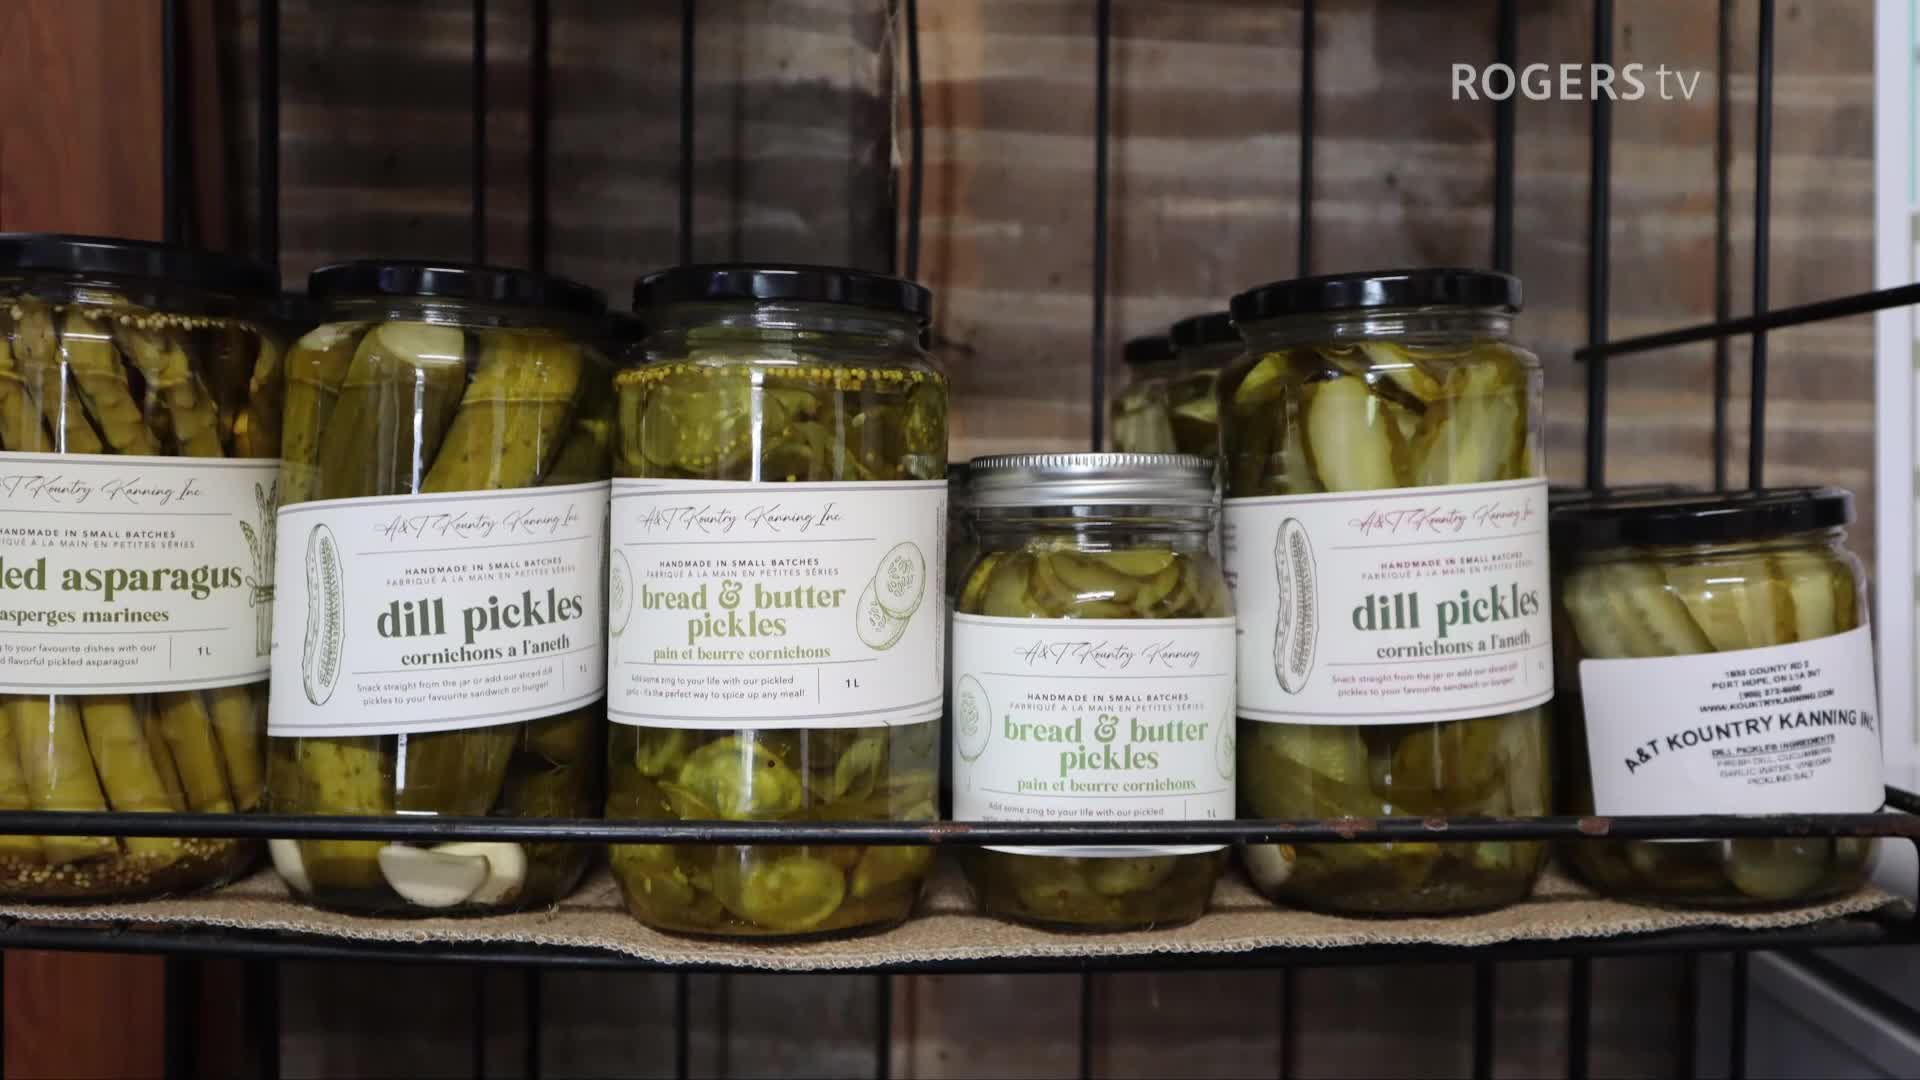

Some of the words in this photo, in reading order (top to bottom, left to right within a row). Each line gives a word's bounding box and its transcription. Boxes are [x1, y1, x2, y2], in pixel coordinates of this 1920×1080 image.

[25, 475, 92, 503] Kountry
[101, 477, 174, 505] Kanning
[432, 512, 497, 538] Kountry
[502, 507, 560, 534] Kanning
[679, 505, 737, 534] Kountry
[745, 504, 815, 532] Kanning
[61, 539, 88, 548] MAIN
[94, 540, 107, 548] EN
[83, 530, 120, 539] SMALL
[126, 531, 176, 539] BATCHES
[405, 564, 467, 575] HANDMADE
[472, 563, 484, 572] IN
[489, 561, 520, 571] SMALL
[524, 557, 562, 568] BATCHES
[659, 559, 712, 568] HANDMADE
[716, 559, 727, 568] IN
[732, 559, 766, 568] SMALL
[771, 558, 819, 567] BATCHES
[1381, 559, 1440, 570] HANDMADE
[1445, 558, 1456, 566] IN
[1460, 556, 1488, 564] SMALL
[469, 573, 494, 582] MAIN
[696, 569, 708, 578] LA
[712, 569, 738, 577] MAIN
[742, 569, 755, 577] EN
[760, 569, 800, 577] PETITES
[61, 565, 242, 602] asparagus
[641, 583, 707, 610] bread
[718, 579, 743, 610] &
[755, 583, 847, 609] butter
[0, 609, 75, 627] asperges
[83, 608, 169, 623] marinees
[376, 597, 446, 639] dill
[462, 586, 583, 645] pickles
[1352, 592, 1420, 631] dill
[1436, 581, 1539, 638] pickles
[688, 610, 787, 645] pickles
[15, 645, 36, 655] your
[39, 643, 80, 653] favourite
[84, 644, 115, 653] dishes
[118, 644, 138, 652] with
[401, 645, 503, 666] cornichons
[508, 647, 517, 657] a
[522, 633, 570, 656] l'aneth
[654, 647, 678, 662] pain
[698, 647, 744, 660] beurre
[749, 646, 831, 660] cornichons
[1072, 641, 1135, 669] Kountry
[1141, 640, 1200, 668] Kanning
[1376, 638, 1474, 660] cornichons
[1478, 640, 1486, 651] a
[8, 657, 45, 667] flavorful
[48, 657, 83, 667] pickled
[357, 683, 381, 693] Snack
[384, 681, 416, 693] straight
[419, 680, 440, 689] from
[442, 678, 457, 688] the
[458, 677, 471, 689] jar
[473, 677, 483, 685] or
[485, 674, 501, 683] add
[502, 673, 517, 681] our
[677, 675, 685, 685] to
[687, 678, 705, 687] your
[707, 675, 720, 685] life
[722, 675, 741, 685] with
[743, 677, 758, 685] our
[761, 674, 794, 686] pickled
[362, 695, 393, 706] pickles
[395, 695, 404, 704] to
[405, 694, 425, 706] your
[428, 691, 468, 702] favourite
[470, 687, 510, 699] sandwich
[665, 689, 691, 699] perfect
[694, 691, 709, 701] way
[711, 690, 720, 699] to
[722, 689, 745, 700] spice
[748, 691, 759, 700] up
[761, 691, 777, 700] any
[1027, 693, 1088, 702] HANDMADE
[1093, 694, 1104, 702] IN
[1109, 694, 1142, 702] SMALL
[1147, 693, 1189, 702] BATCHES
[1072, 703, 1083, 712] LA
[1088, 703, 1114, 712] MAIN
[1119, 703, 1131, 712] EN
[1004, 714, 1082, 743] bread
[1094, 713, 1119, 743] &
[1130, 718, 1208, 743] butter
[1624, 739, 1661, 774] A&T
[1666, 715, 1773, 752] KOUNTRY
[1779, 709, 1857, 731] KANNING
[1060, 743, 1159, 777] pickles
[1017, 778, 1048, 793] pain
[1070, 778, 1119, 793] beurre
[1123, 778, 1197, 793] cornichons
[1026, 807, 1044, 818] zing
[1046, 806, 1056, 816] to
[1057, 808, 1078, 819] your
[1080, 806, 1094, 817] life
[1096, 806, 1114, 817] with
[1117, 808, 1132, 817] our
[1133, 806, 1164, 819] pickled
